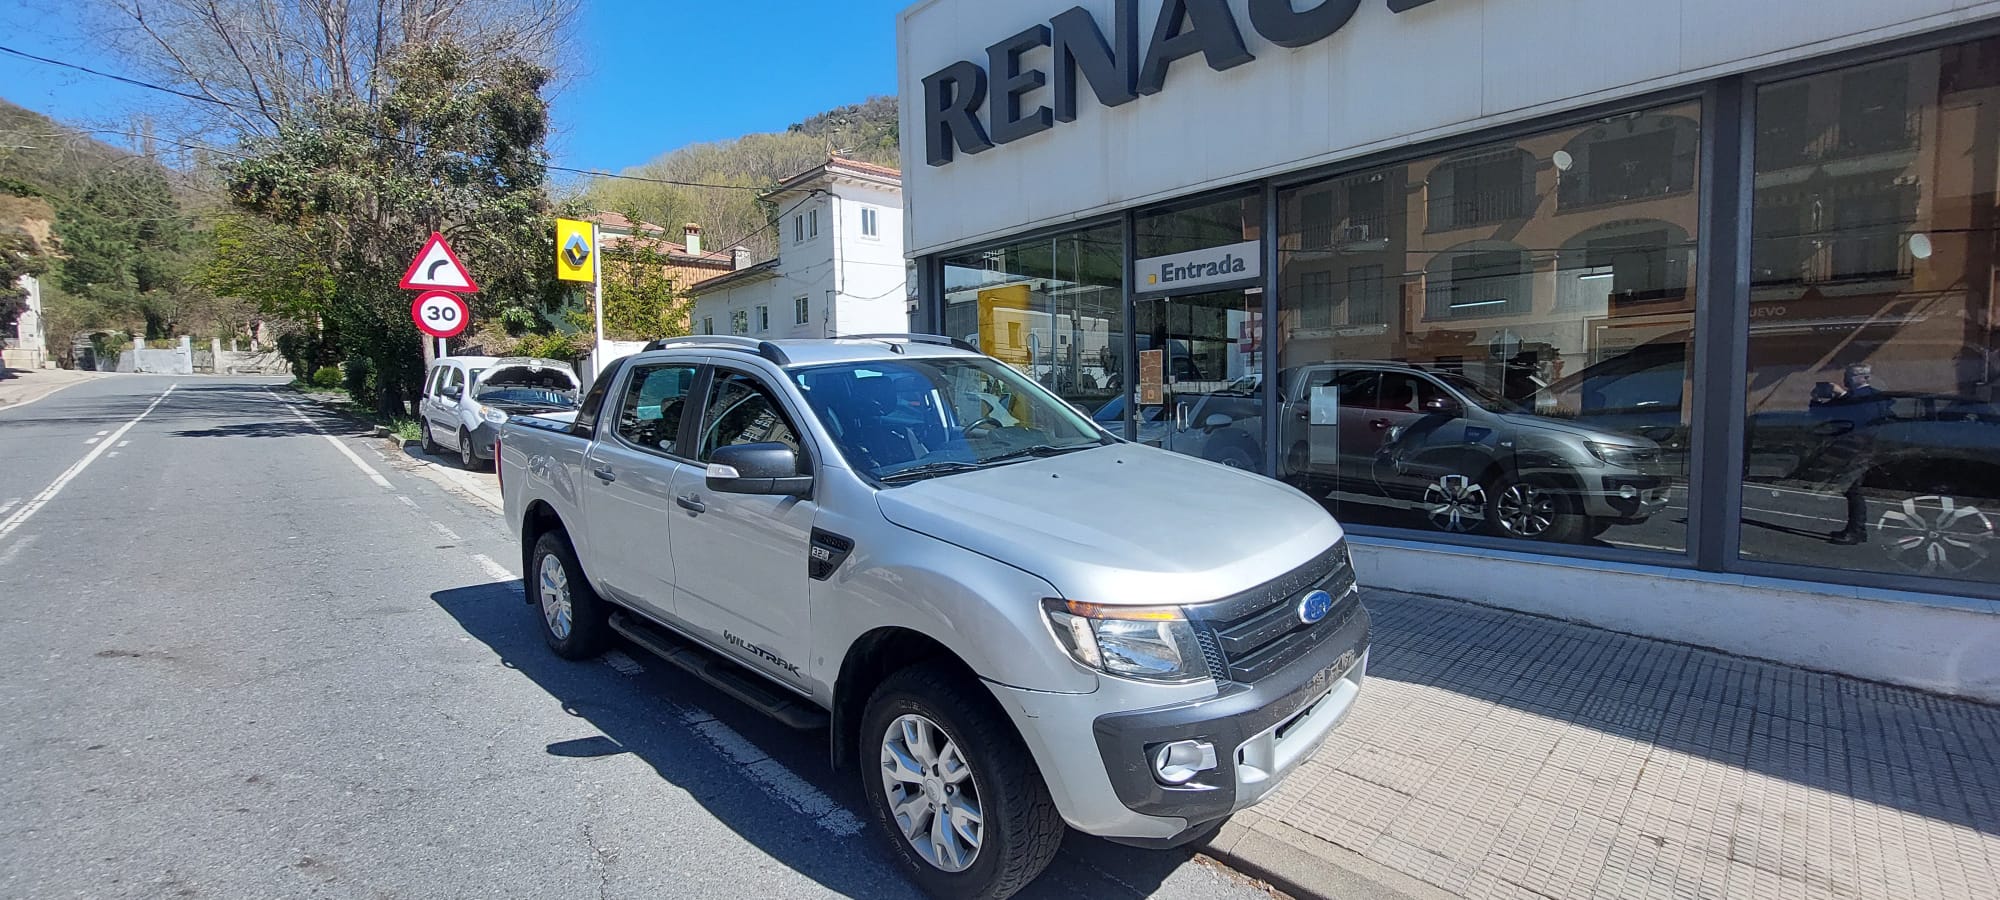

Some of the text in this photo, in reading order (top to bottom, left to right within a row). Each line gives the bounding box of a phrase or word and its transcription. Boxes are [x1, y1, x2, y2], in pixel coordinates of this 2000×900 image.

[921, 0, 1435, 167] RENA
[1161, 253, 1246, 283] Entrada
[427, 305, 456, 322] 30
[1750, 306, 1786, 317] UEVO
[723, 629, 802, 679] WILDTRAK
